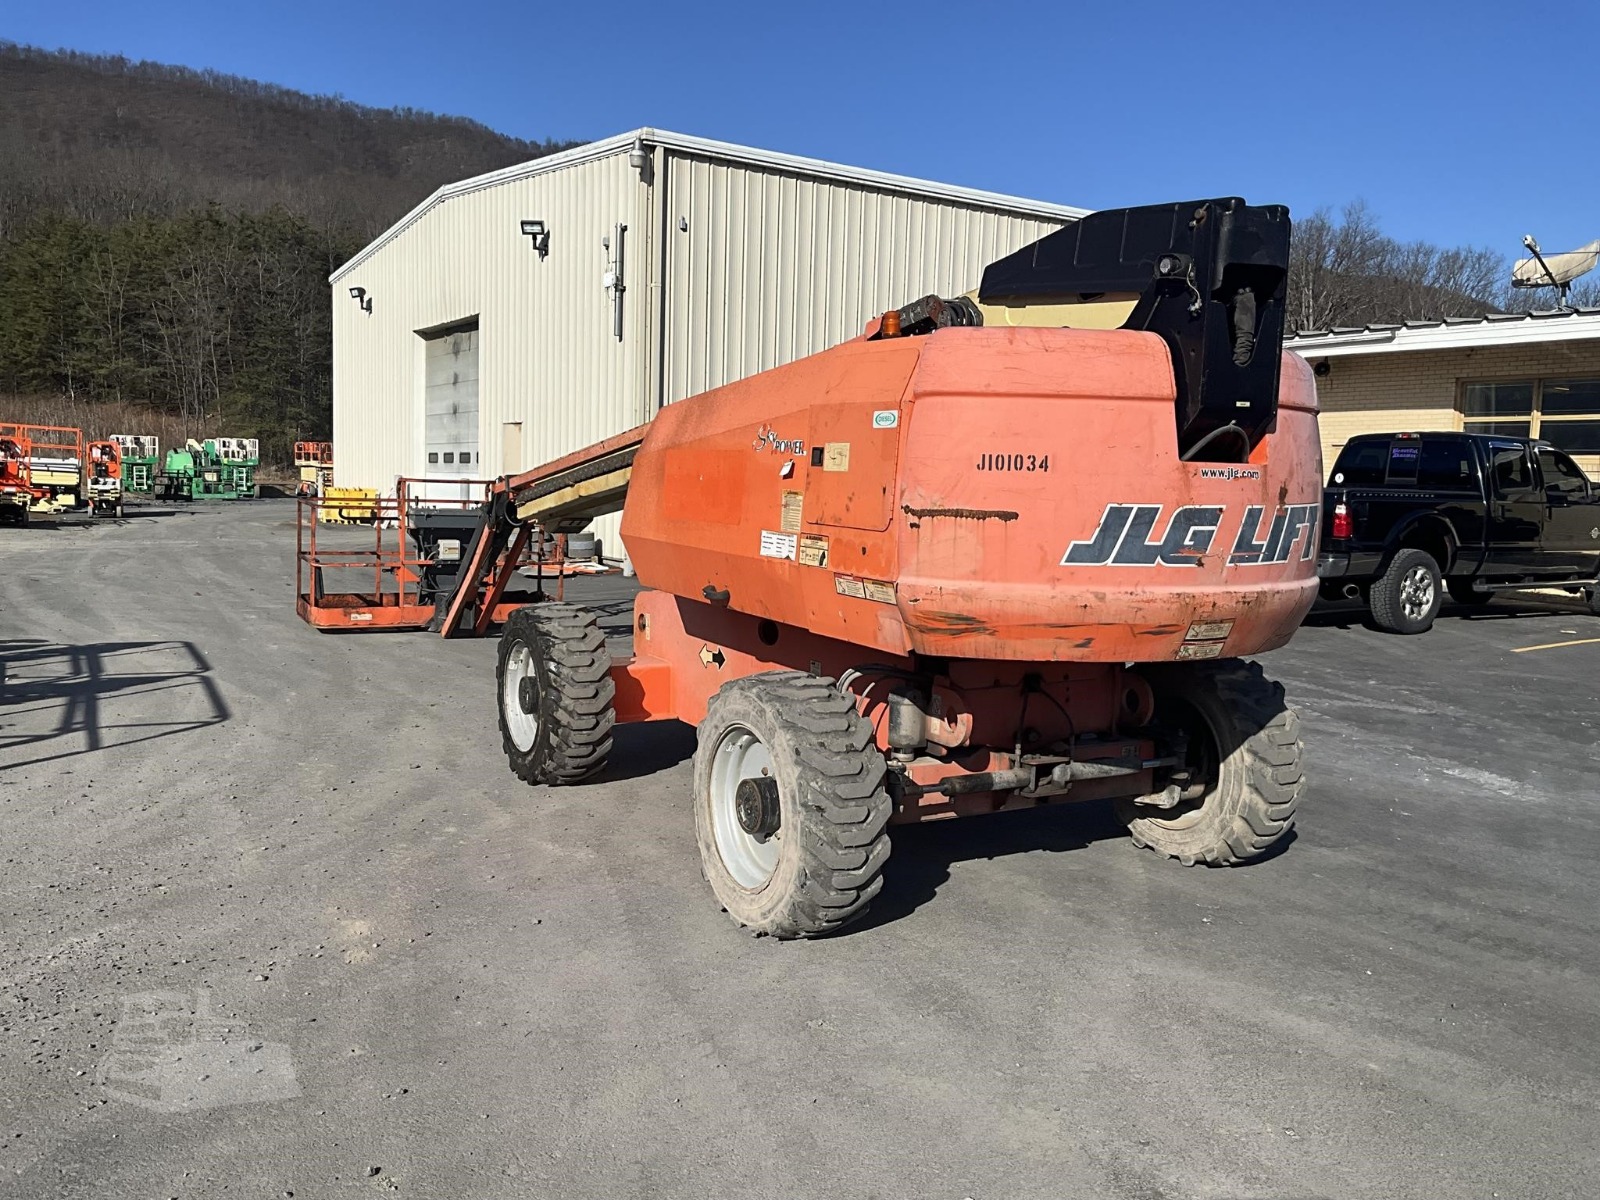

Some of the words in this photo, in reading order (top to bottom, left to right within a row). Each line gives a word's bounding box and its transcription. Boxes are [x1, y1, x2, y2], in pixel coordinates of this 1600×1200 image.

[976, 453, 1049, 473] J101034
[1201, 467, 1260, 481] www.jlg.com
[1060, 502, 1227, 567] JLG
